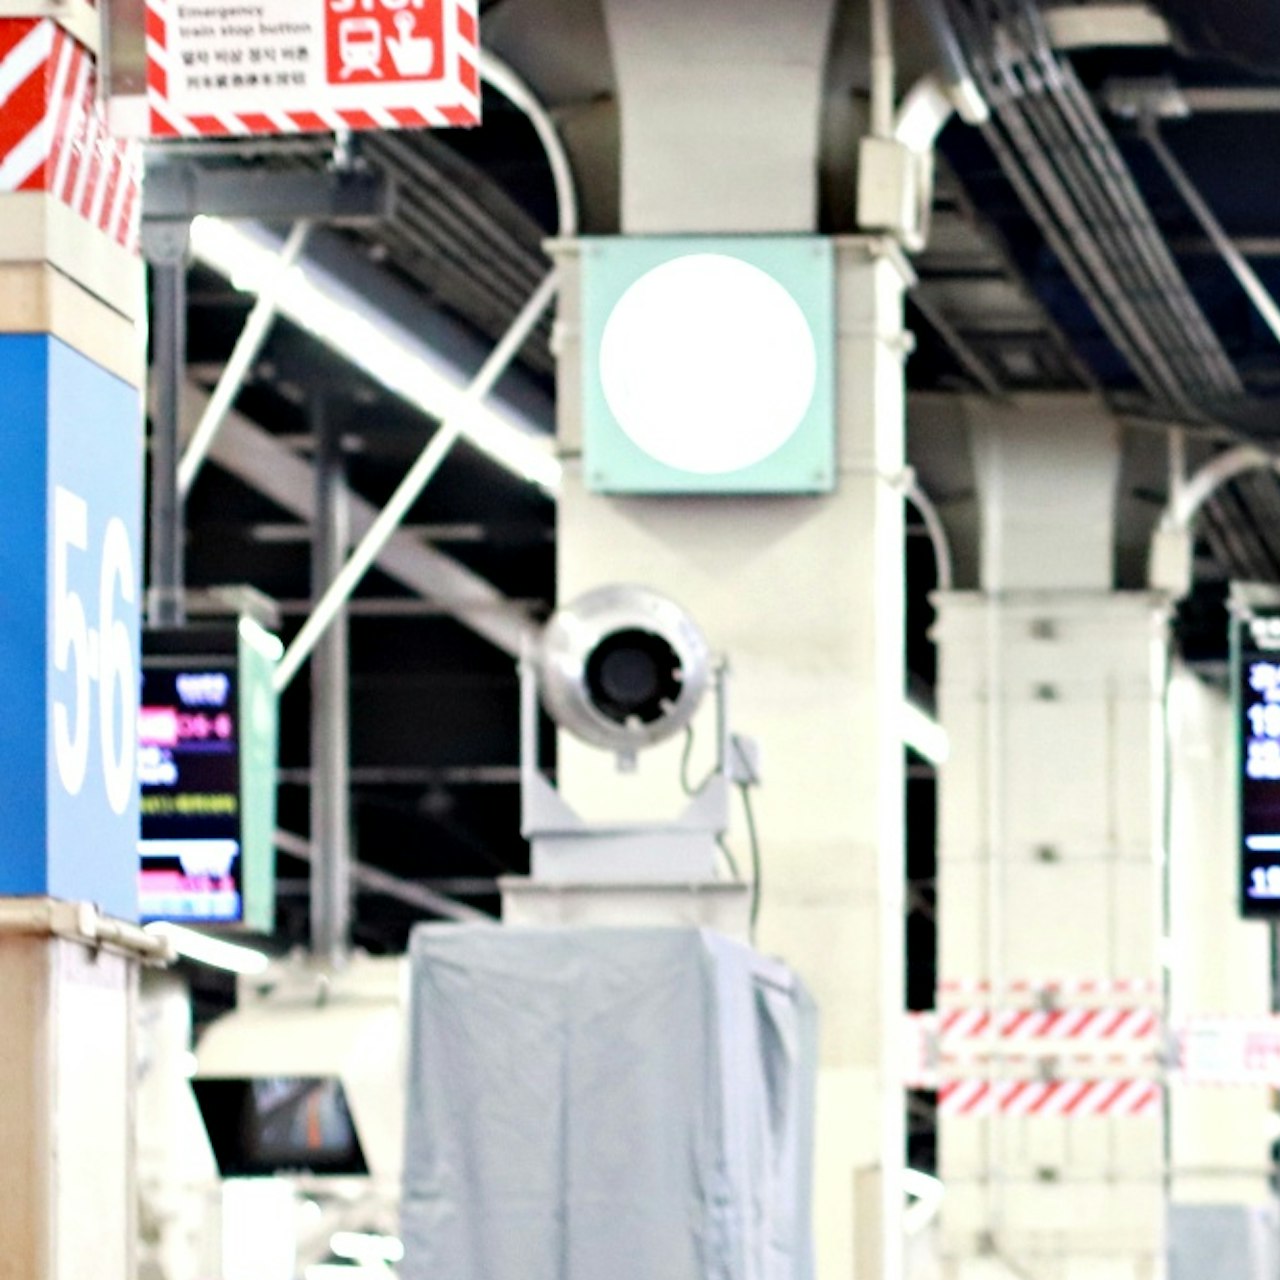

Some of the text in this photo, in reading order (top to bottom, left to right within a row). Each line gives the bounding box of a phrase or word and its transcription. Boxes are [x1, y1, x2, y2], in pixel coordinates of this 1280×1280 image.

[177, 4, 263, 18] Emergency
[179, 20, 312, 37] train stop button
